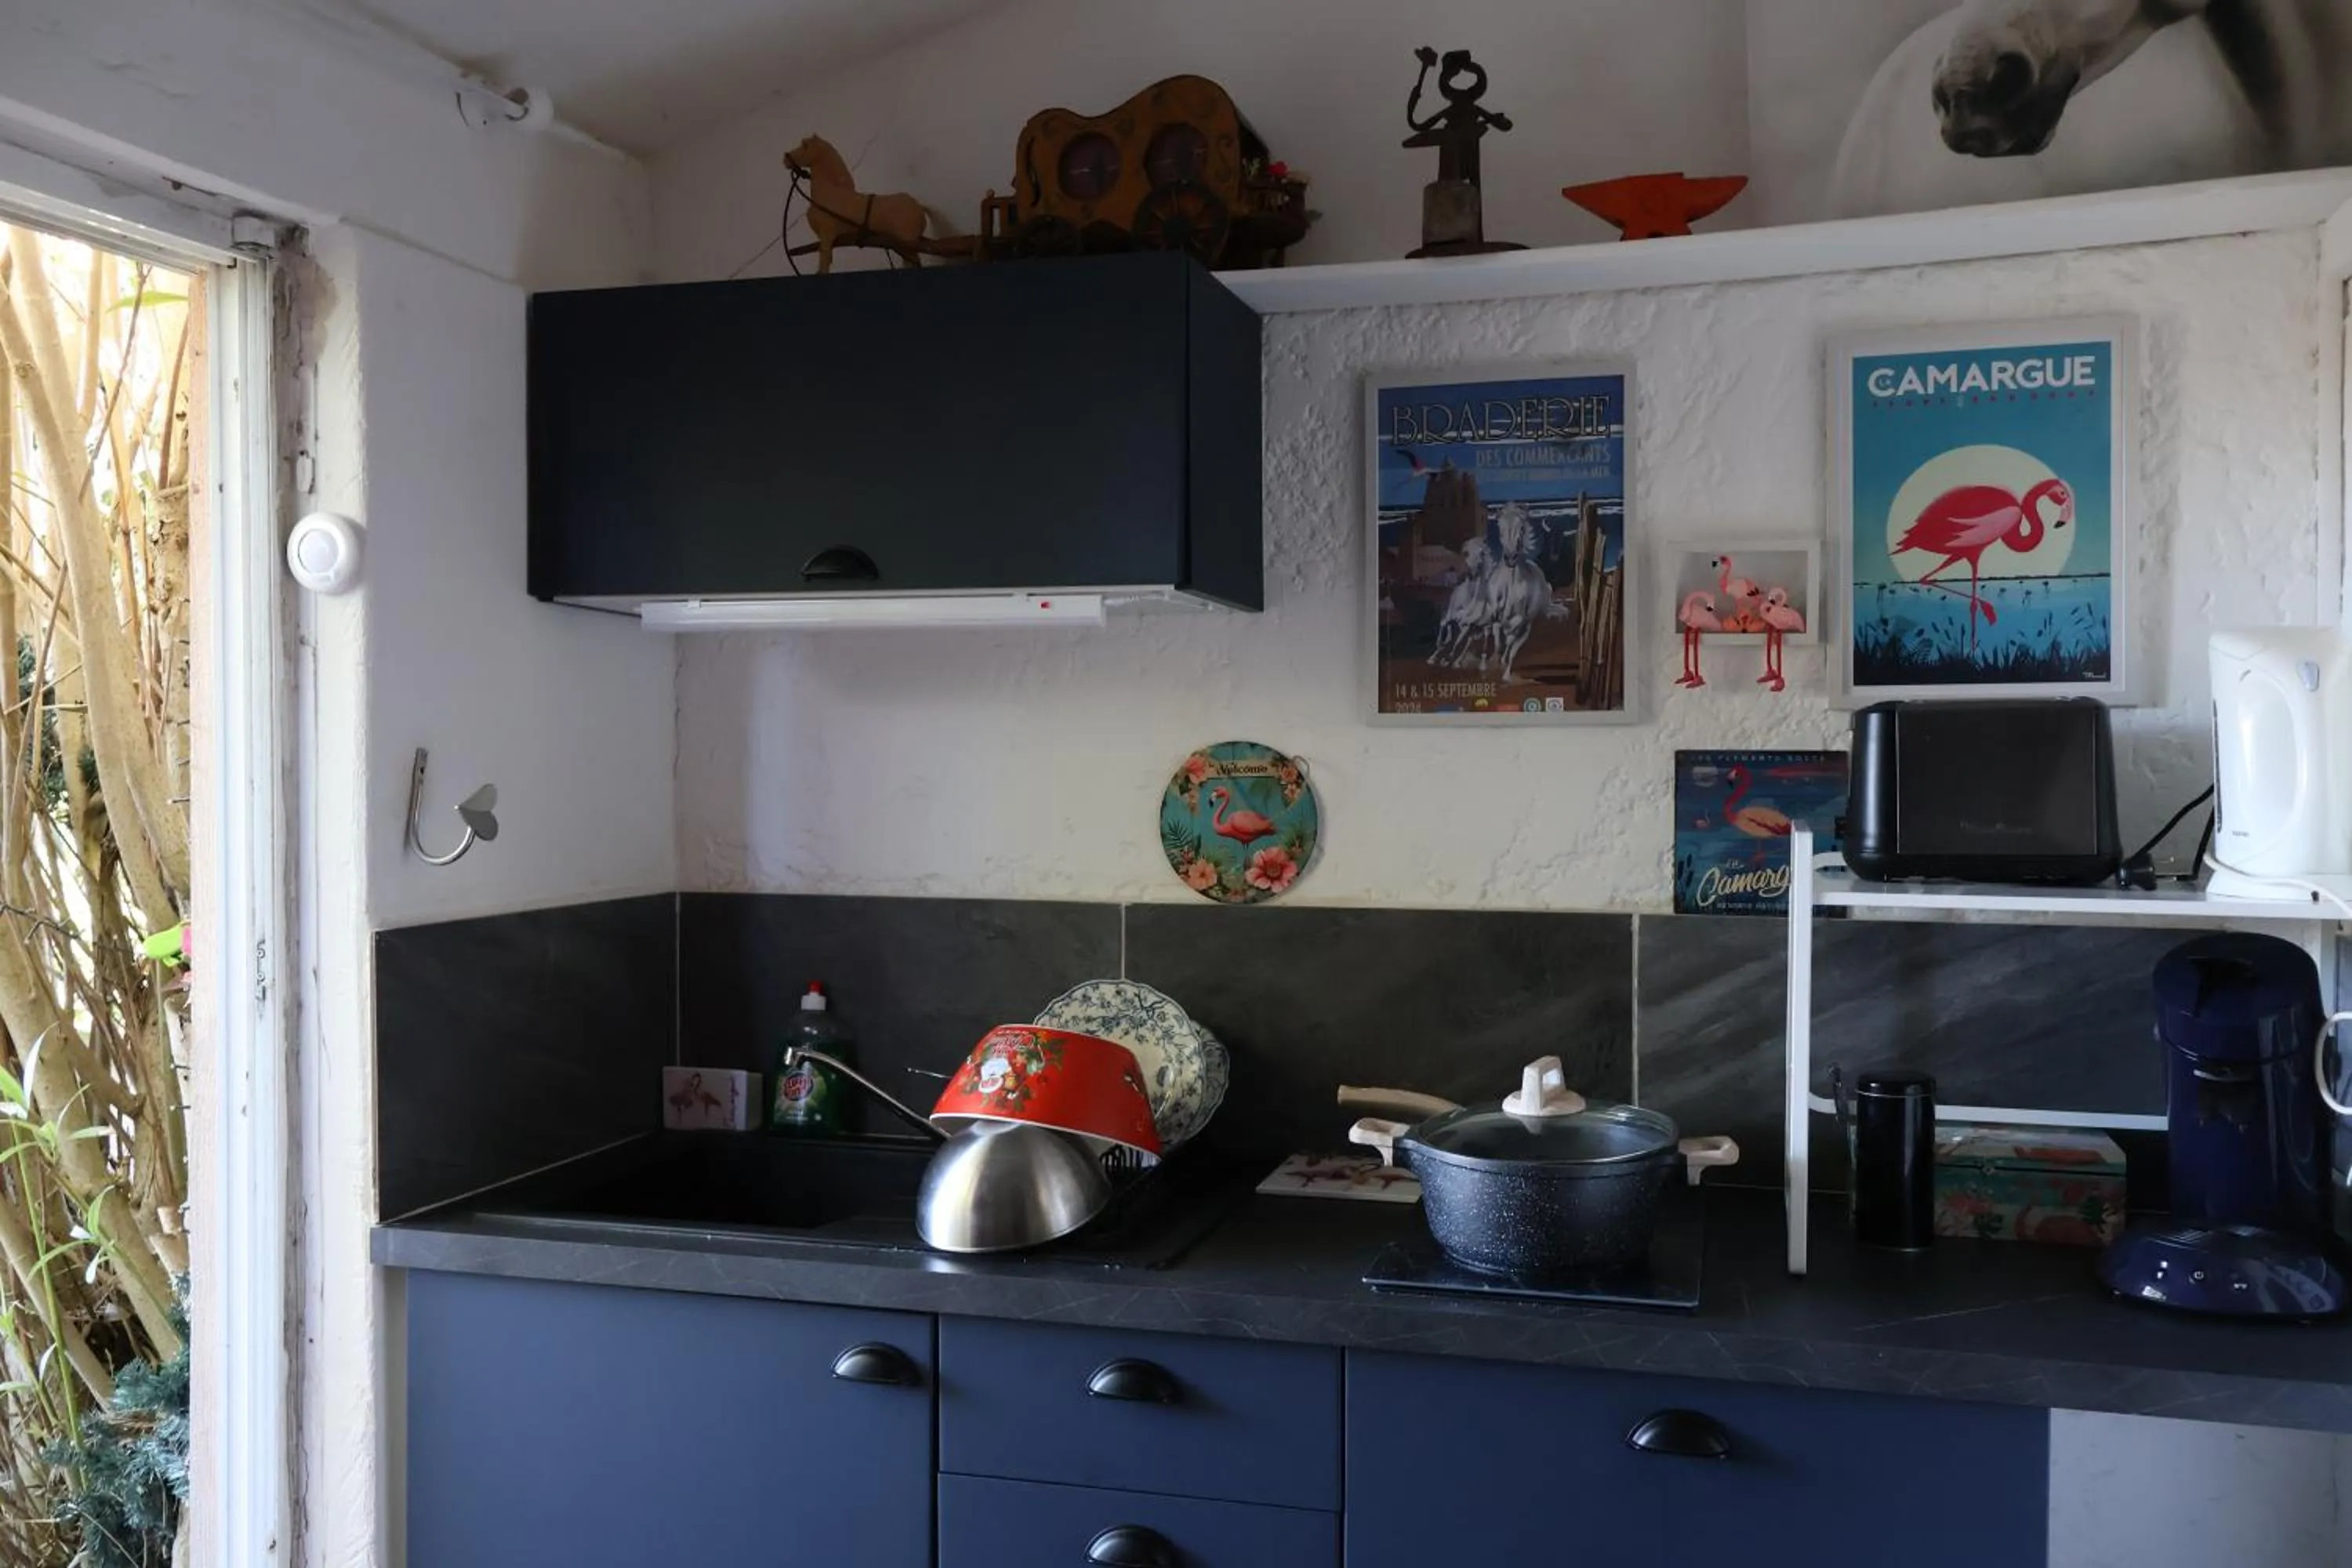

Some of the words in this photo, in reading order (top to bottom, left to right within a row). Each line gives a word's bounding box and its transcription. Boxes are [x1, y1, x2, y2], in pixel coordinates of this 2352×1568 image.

[1867, 355, 2096, 397] CAMARGUE
[1391, 394, 1612, 445] BRADERIE
[1475, 448, 1501, 468] DES
[1395, 682, 1406, 699] 14
[1422, 682, 1433, 699] 15
[1436, 682, 1497, 699] SEPTEMBRE
[1215, 763, 1269, 776] Welcome
[1695, 864, 1792, 908] Camarg
